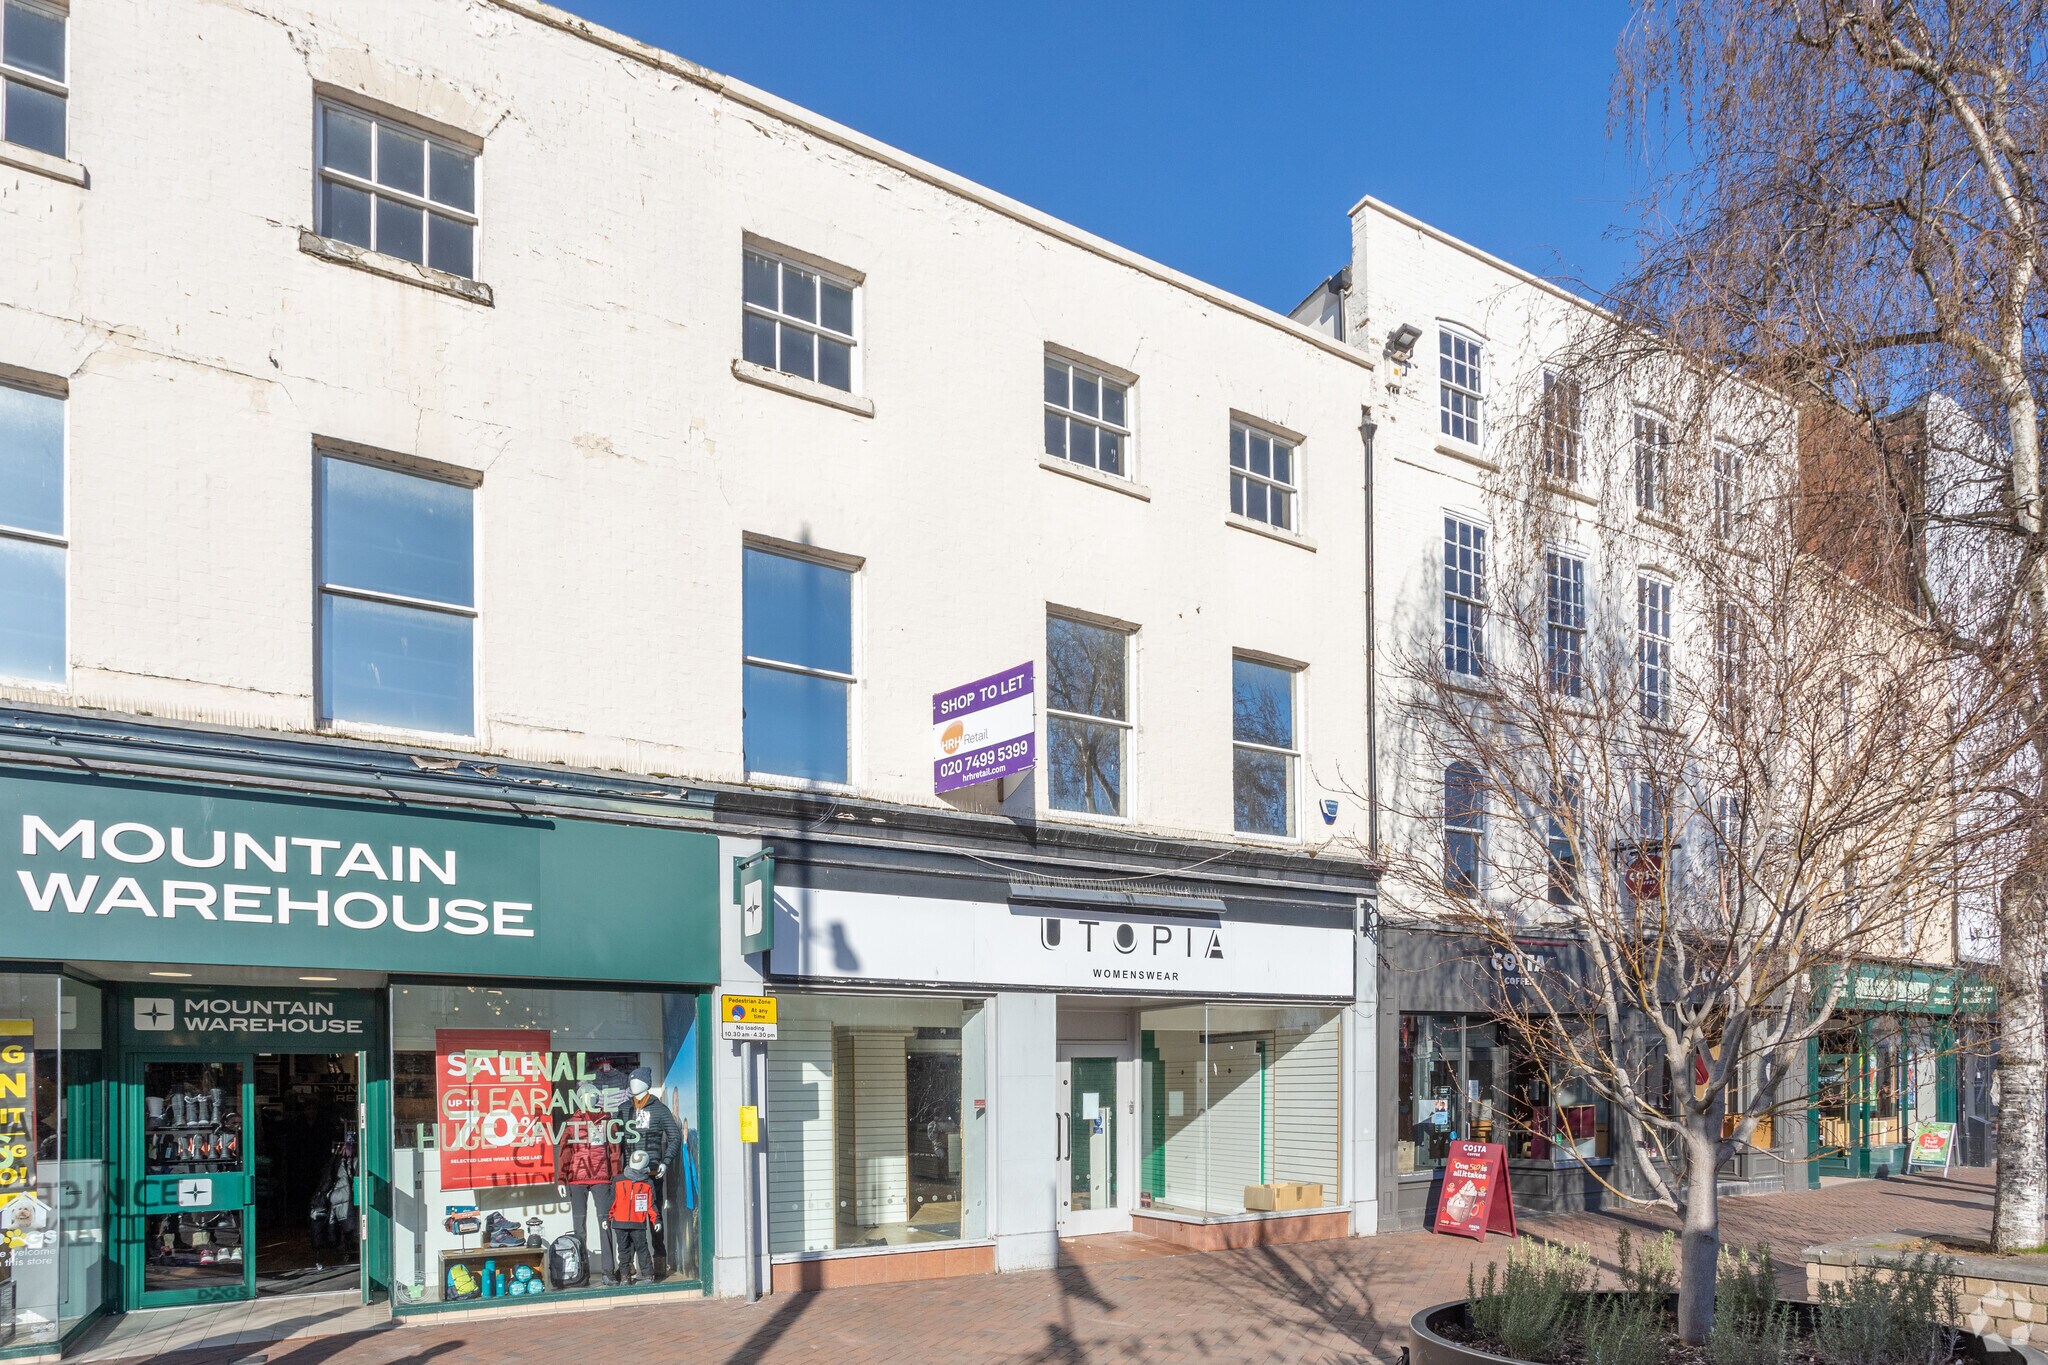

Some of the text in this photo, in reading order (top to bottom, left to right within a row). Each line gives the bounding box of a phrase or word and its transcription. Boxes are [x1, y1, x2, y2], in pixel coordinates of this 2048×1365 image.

[941, 674, 1024, 714] SHOP TO LET
[941, 728, 989, 751] HRH Retail
[940, 740, 1028, 777] 020 7499 5399
[962, 765, 1006, 782] hrhretail.com
[22, 814, 457, 886] MOUNTAIN
[16, 870, 535, 937] WAREHOUSE
[1041, 917, 1224, 959] UTOPIA
[1093, 968, 1179, 981] WOMENSWEAR
[1504, 976, 1535, 985] COFFE
[184, 999, 334, 1016] MOUNTAIN
[183, 1017, 363, 1034] WAREHOUSE
[465, 1049, 597, 1083] FINAL
[441, 1087, 620, 1119] CLEARANCE
[448, 1099, 480, 1107] UP TO
[417, 1122, 499, 1153] HUGE
[510, 1118, 641, 1148] SAVINGS
[1463, 1144, 1487, 1153] COSTA
[1455, 1162, 1469, 1170] One
[12, 1247, 56, 1258] welcome
[5, 1257, 52, 1266] this store
